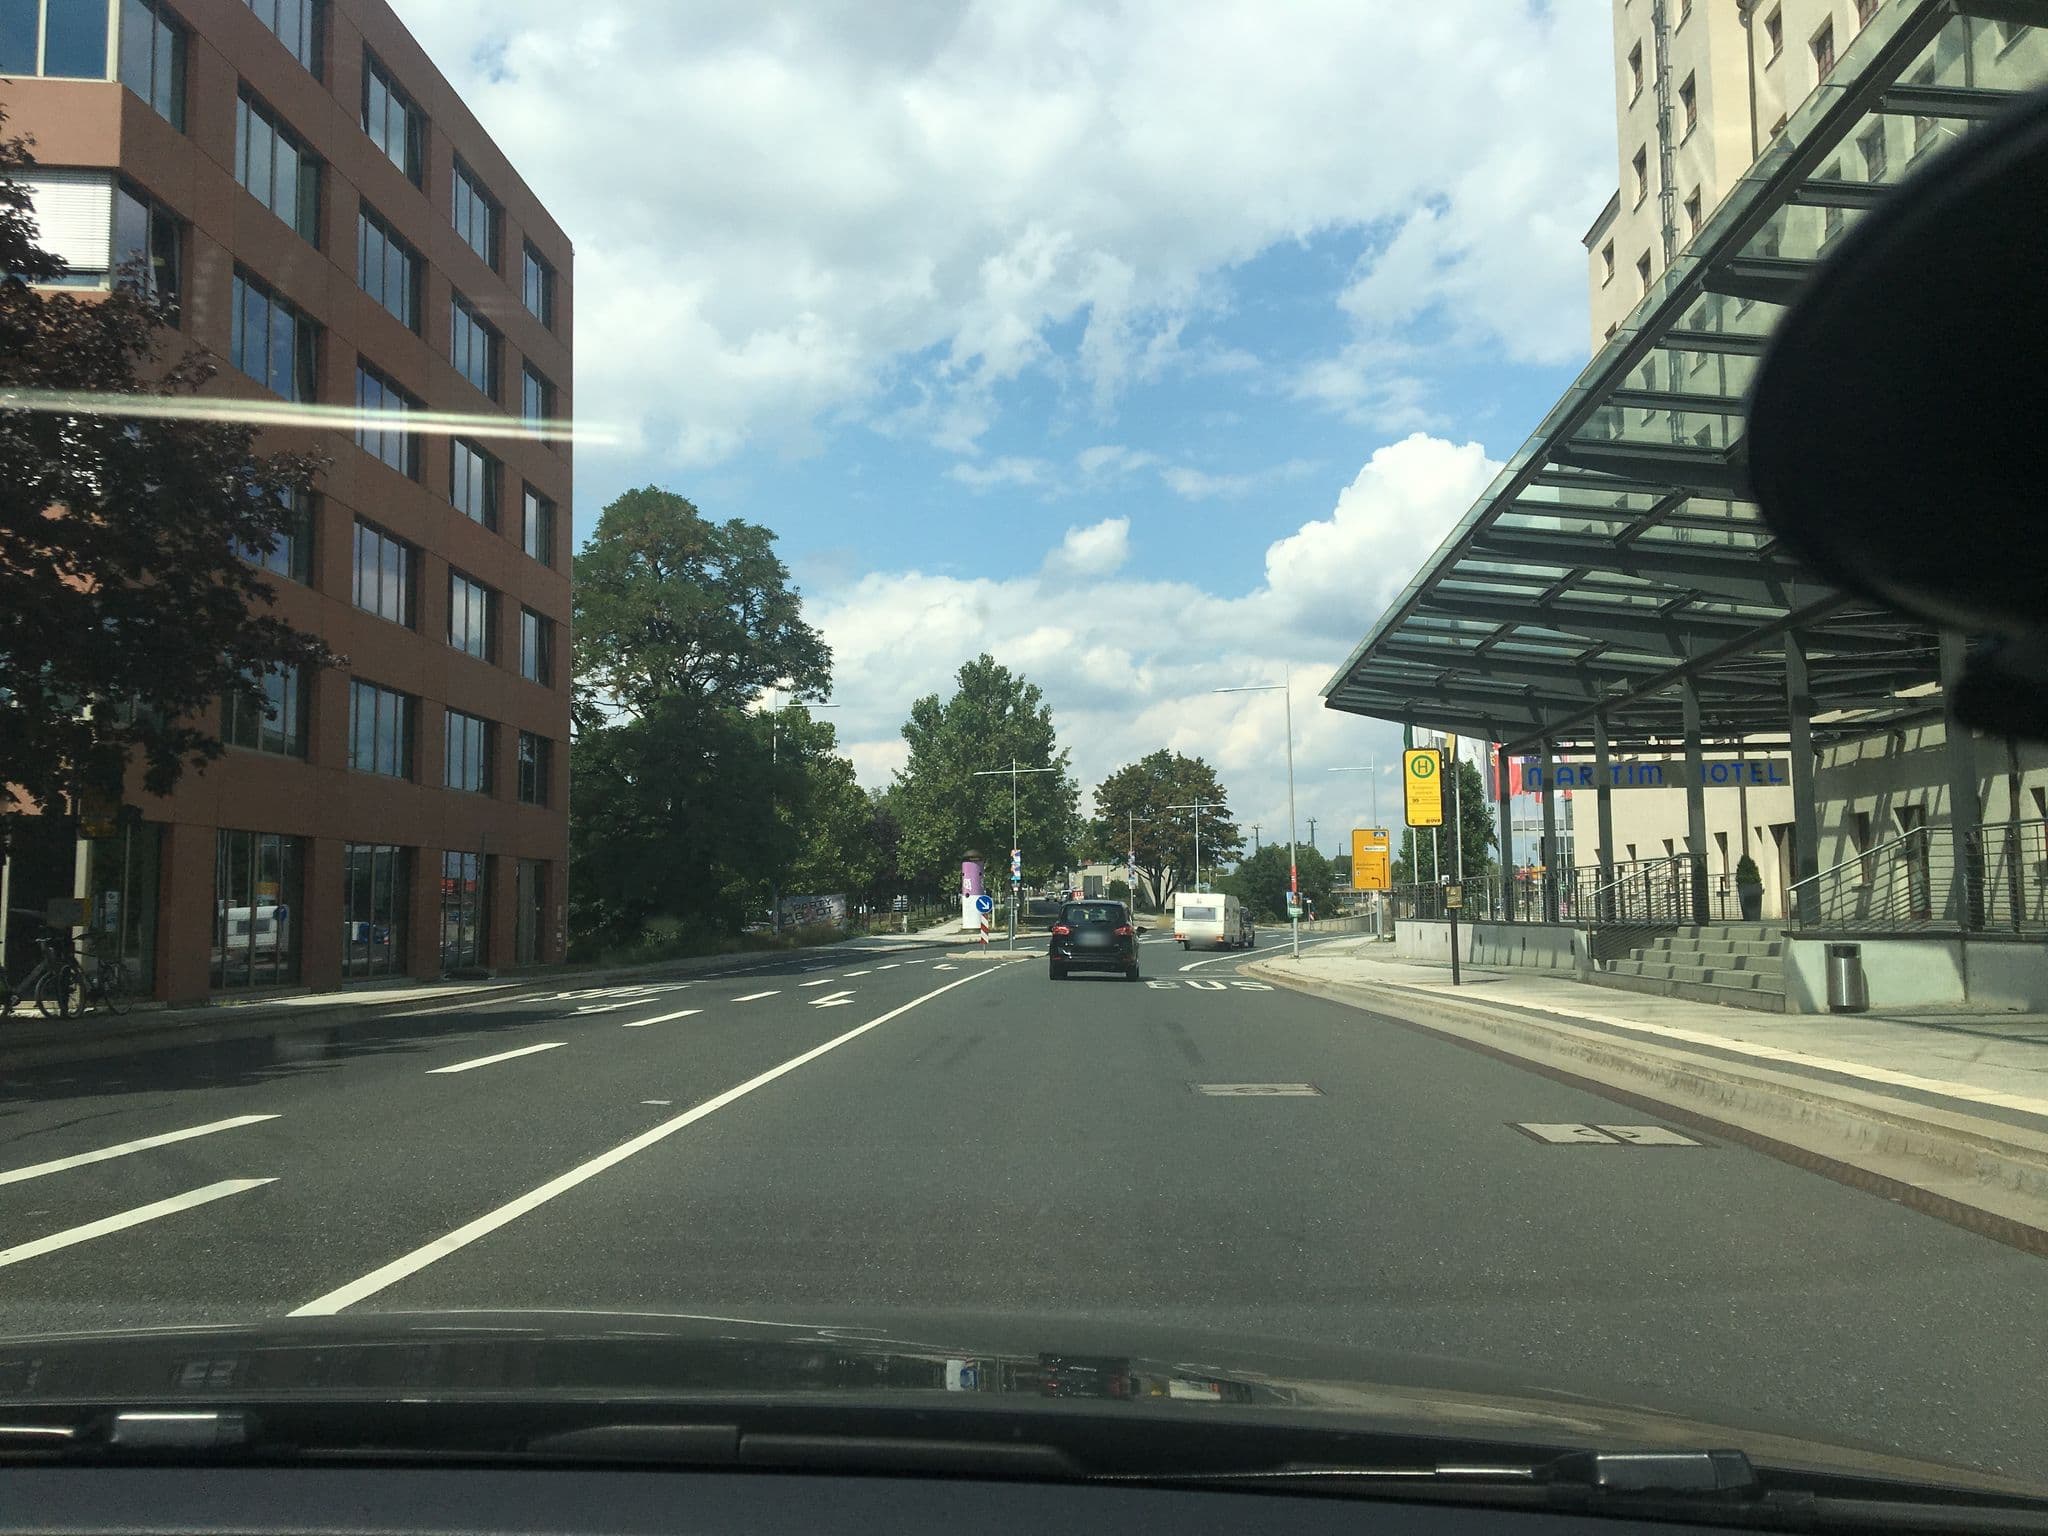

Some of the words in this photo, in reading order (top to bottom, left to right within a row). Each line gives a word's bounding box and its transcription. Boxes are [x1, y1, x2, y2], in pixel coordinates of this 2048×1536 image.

[1418, 760, 1428, 773] H
[1527, 763, 1663, 787] MARTIM
[1701, 762, 1784, 785] OTEL
[1145, 980, 1275, 991] BUS
